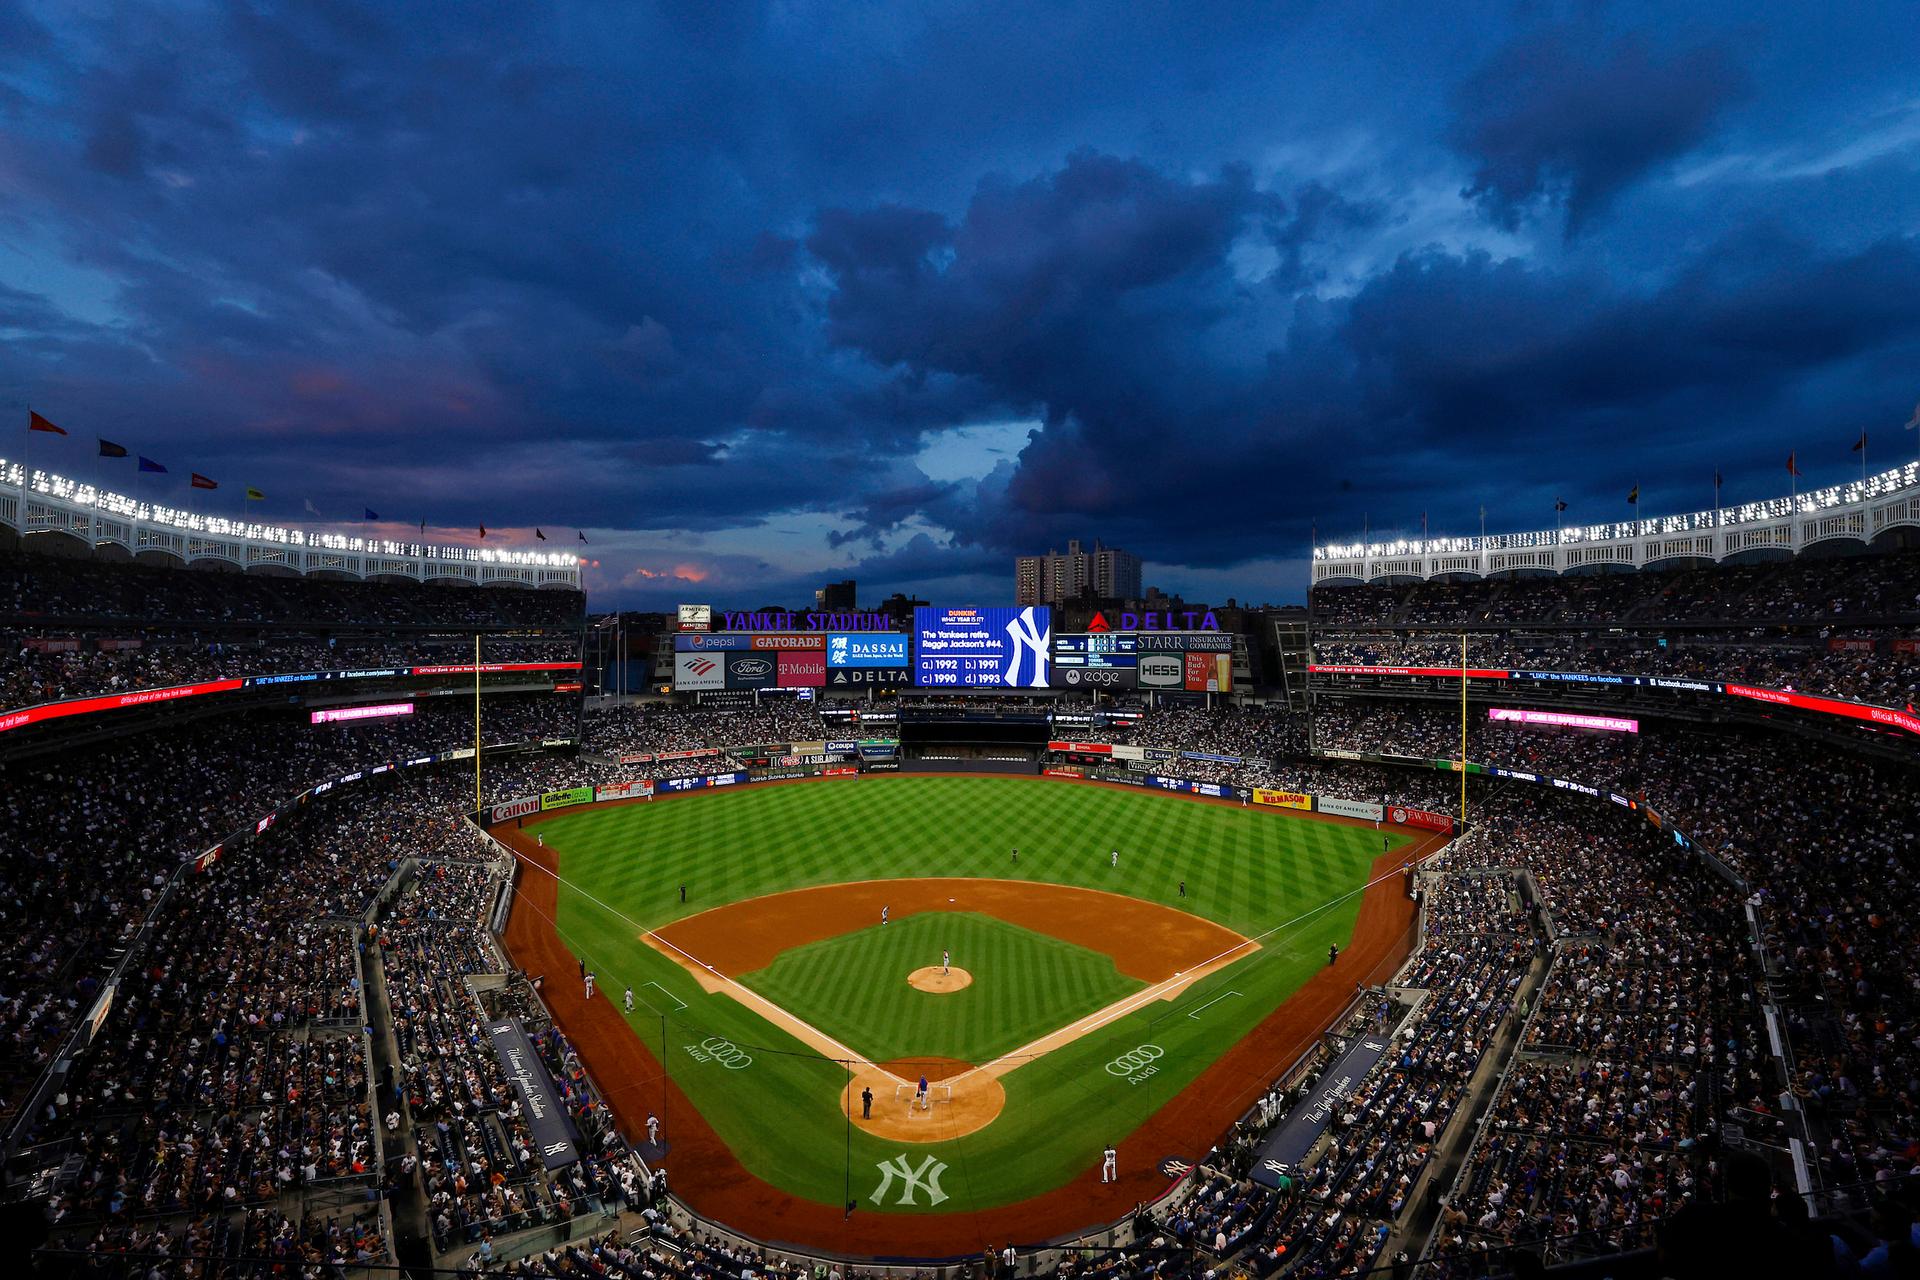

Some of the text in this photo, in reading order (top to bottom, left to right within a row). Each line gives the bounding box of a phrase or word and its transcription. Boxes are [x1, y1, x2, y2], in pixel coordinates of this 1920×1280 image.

[724, 612, 889, 631] YANKEE STADIUM
[1121, 611, 1219, 630] DELTA
[938, 630, 968, 638] Yankees
[706, 637, 735, 648] pepsi
[756, 637, 821, 648] GATORADE
[922, 640, 1003, 650] Reggie Jackson's #44.
[1138, 636, 1184, 649] STARR
[852, 644, 903, 653] DASSAI
[738, 662, 764, 672] Ford
[790, 663, 824, 674] Mobile
[922, 660, 998, 670] a.) 1992 b.) 1991
[1142, 665, 1179, 676] HESS
[347, 670, 394, 678] facebook.com/yankees
[852, 671, 908, 682] DELTA
[922, 674, 1000, 684] c.) 1990 d.) 1993
[1084, 670, 1120, 686] edge
[1598, 676, 1622, 684] facebook
[121, 696, 138, 704] Official
[328, 712, 340, 721] THE
[340, 710, 362, 718] LEADER
[1872, 710, 1893, 722] Official
[1558, 715, 1576, 724] BARS
[1584, 717, 1605, 726] MORE
[1606, 720, 1632, 730] PLACES
[804, 756, 810, 764] A
[810, 755, 823, 764] SUB
[1512, 772, 1536, 782] YANKEES
[1554, 779, 1569, 789] SEPT
[545, 790, 588, 804] Gillette labs
[493, 800, 538, 820] Canon
[1344, 806, 1368, 814] AMERICA
[1408, 811, 1450, 826] F.W. WEBB
[507, 1048, 524, 1069] Welcome
[683, 1045, 711, 1063] Audi
[1128, 1065, 1160, 1085] Audi
[511, 1072, 537, 1095] Yankee
[1302, 1076, 1351, 1124] New York Yankees
[526, 1094, 546, 1119] Stadium
[866, 1153, 950, 1206] NY
